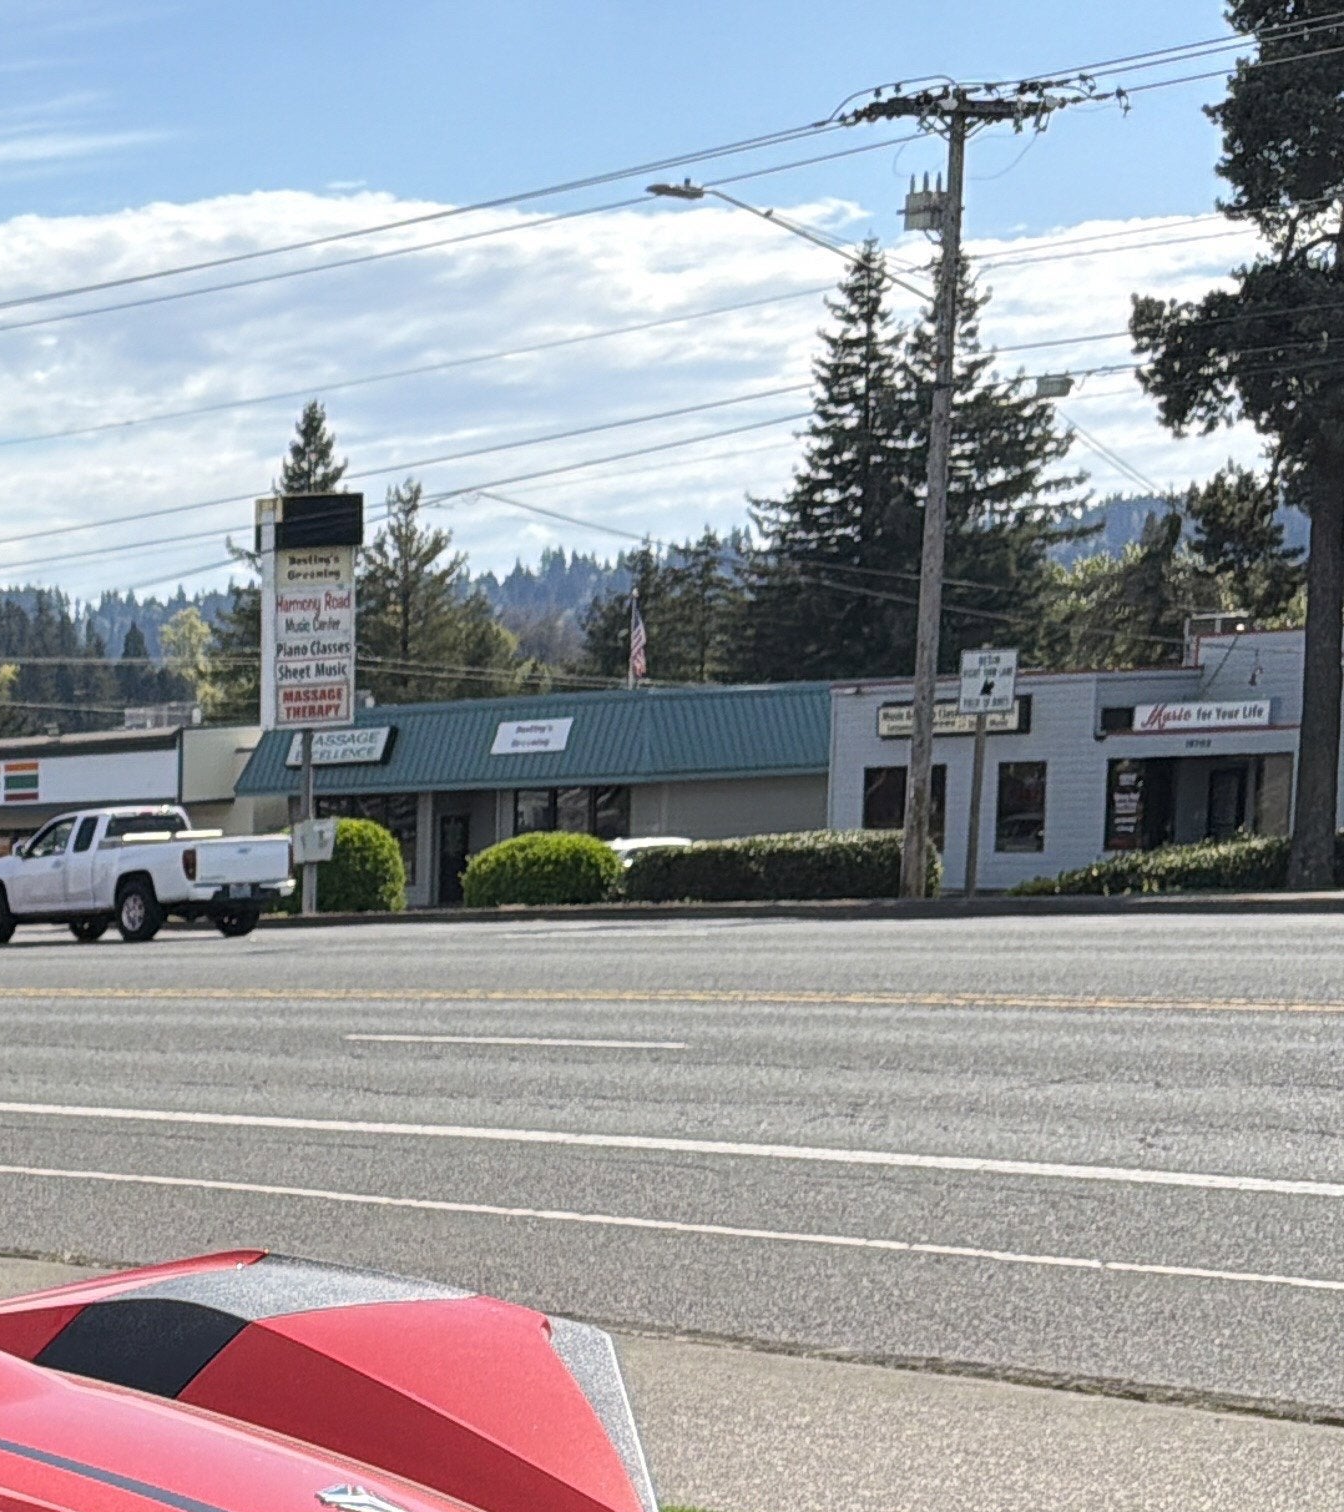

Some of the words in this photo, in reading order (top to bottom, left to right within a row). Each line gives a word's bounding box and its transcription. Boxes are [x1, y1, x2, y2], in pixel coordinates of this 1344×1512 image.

[276, 594, 321, 621] Harmony
[324, 590, 351, 611] Road
[276, 643, 309, 657] Piano
[310, 640, 351, 656] Classes
[278, 665, 310, 681] Sheet
[315, 661, 347, 677] Music
[283, 688, 343, 704] MASSAGE
[285, 703, 341, 719] THERAPY
[1141, 702, 1192, 730] Music
[1197, 706, 1212, 721] for
[1216, 706, 1240, 720] Your
[1242, 704, 1264, 719] Life
[313, 731, 380, 747] ASSAGE
